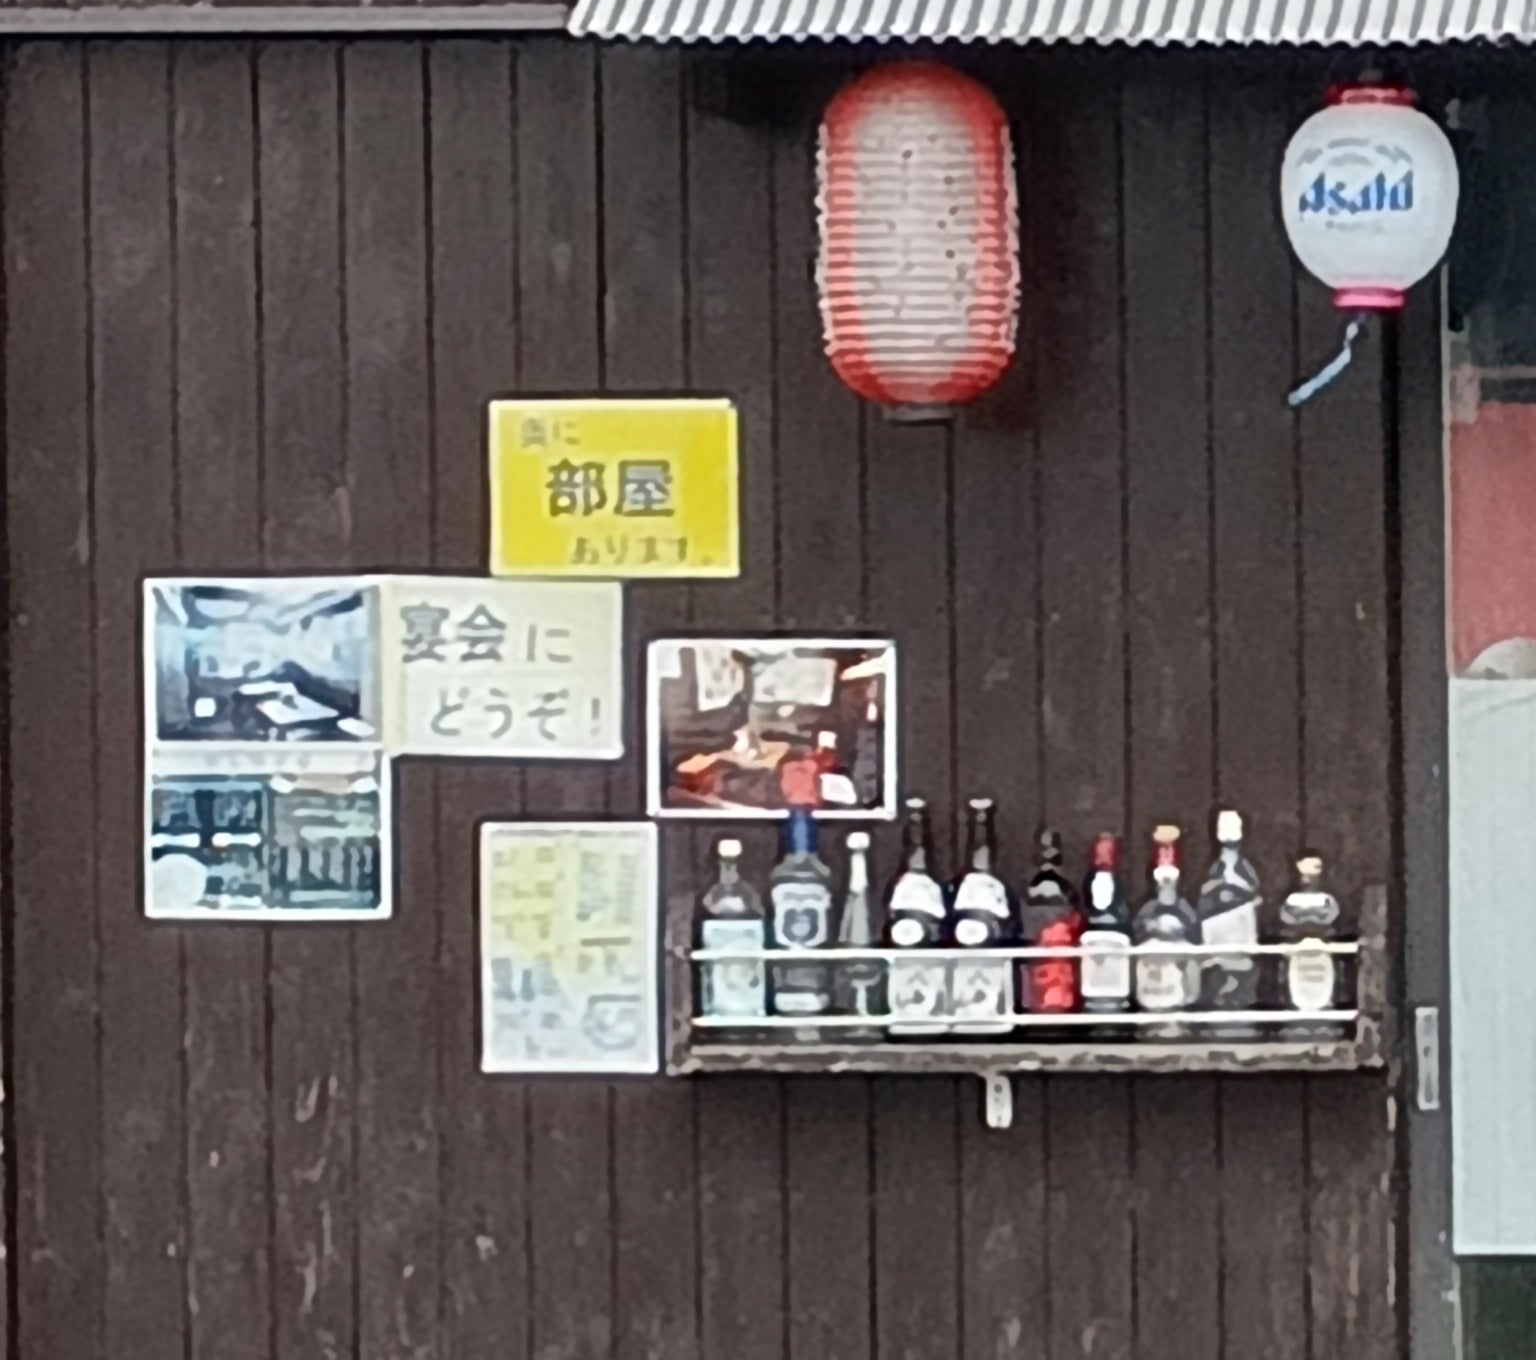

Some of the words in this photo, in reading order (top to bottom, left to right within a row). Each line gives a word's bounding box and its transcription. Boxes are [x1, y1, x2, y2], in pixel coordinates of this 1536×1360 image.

[1299, 169, 1414, 215] Asahi
[546, 458, 675, 517] 部屋
[400, 601, 572, 664] 宴会に
[430, 687, 601, 740] どうぞ！
